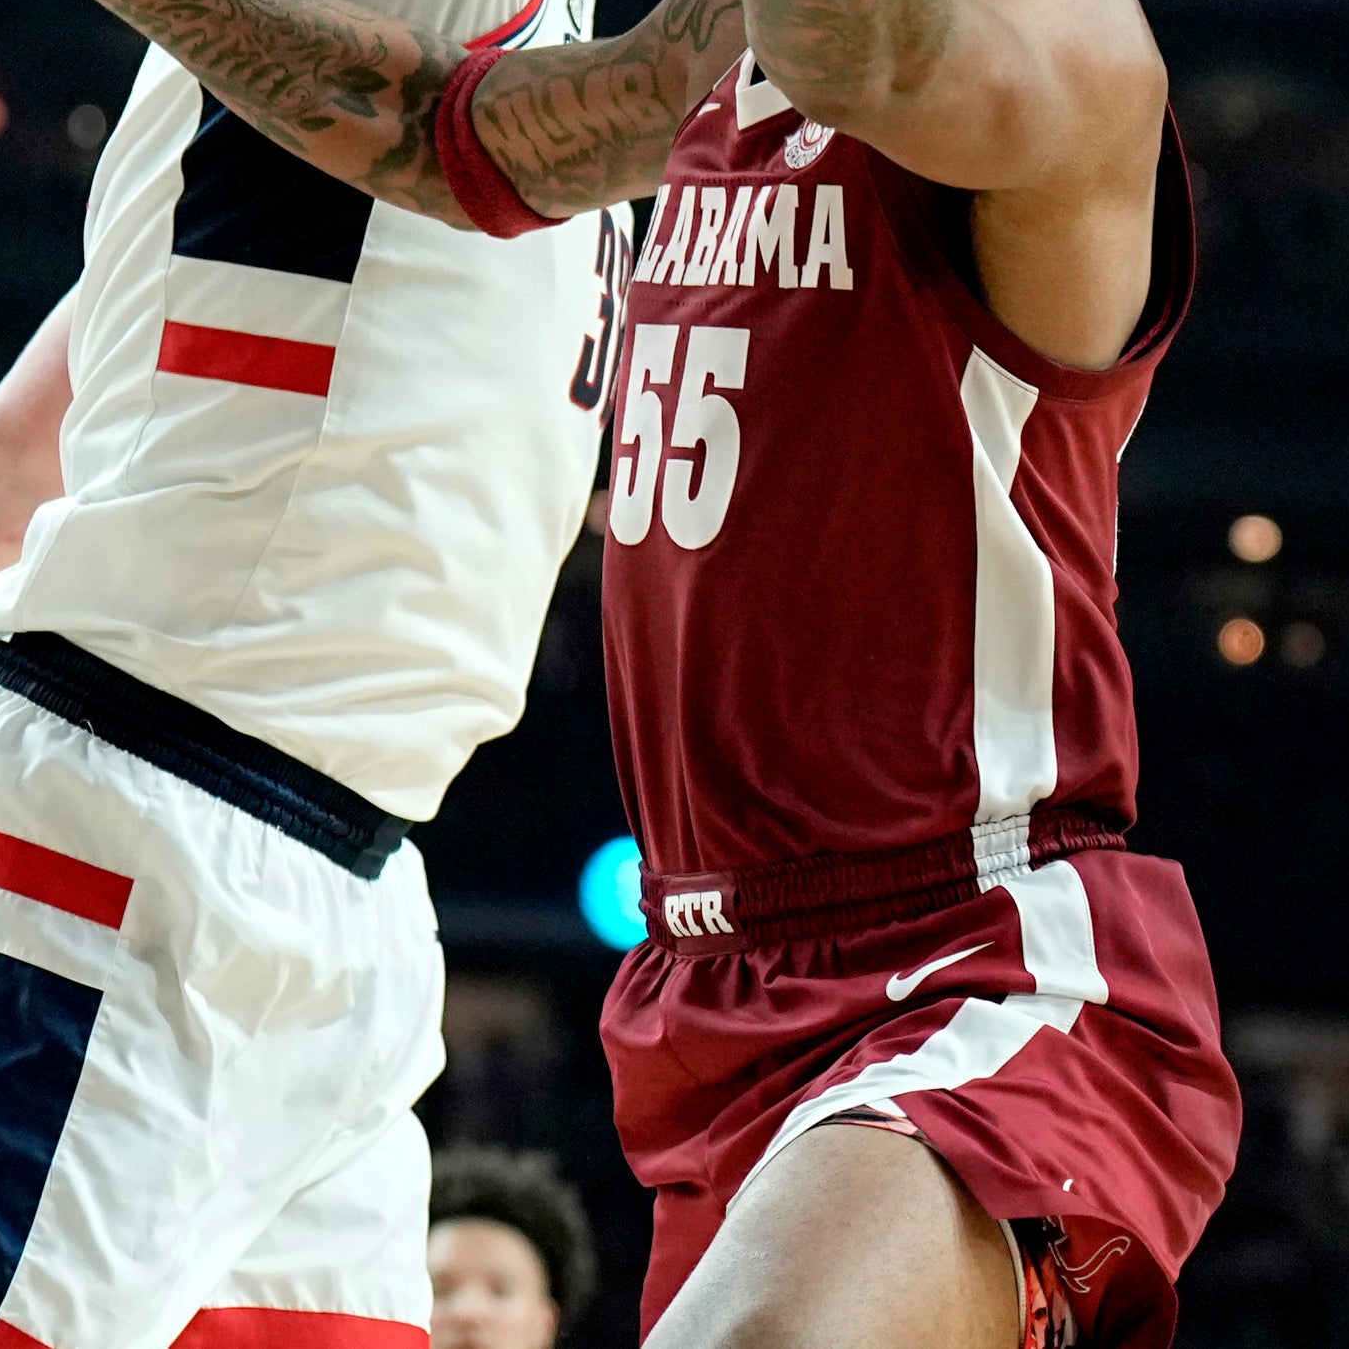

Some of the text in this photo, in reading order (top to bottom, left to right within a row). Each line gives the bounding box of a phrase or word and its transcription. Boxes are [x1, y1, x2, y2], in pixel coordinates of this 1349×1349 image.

[631, 183, 854, 291] LABAMA
[609, 323, 751, 551] 55
[664, 890, 735, 938] RTR
